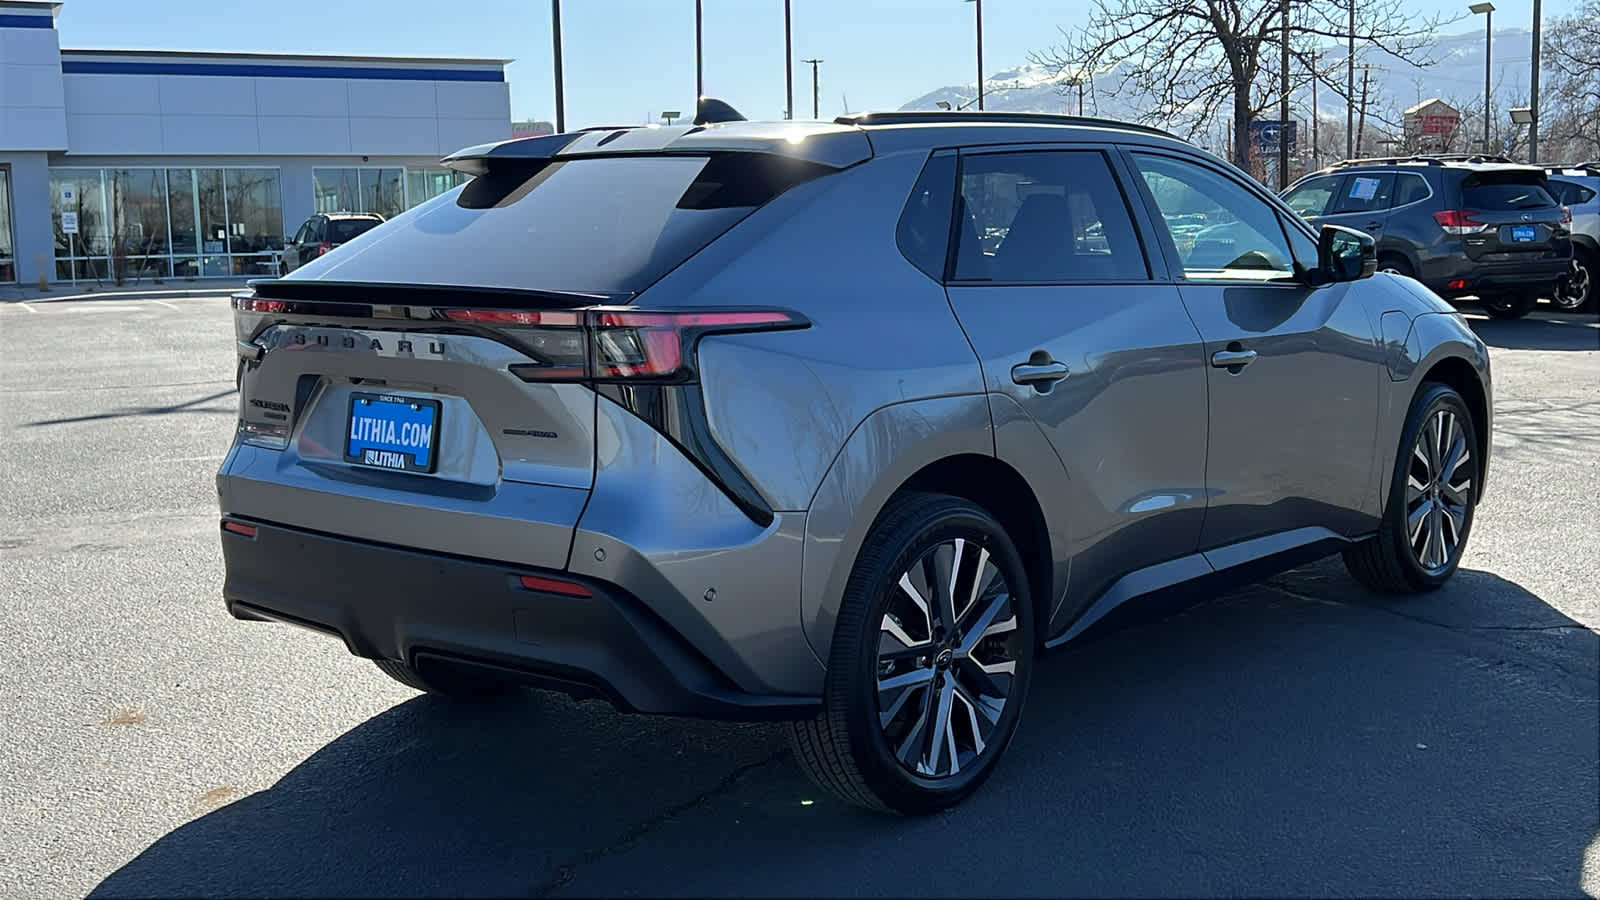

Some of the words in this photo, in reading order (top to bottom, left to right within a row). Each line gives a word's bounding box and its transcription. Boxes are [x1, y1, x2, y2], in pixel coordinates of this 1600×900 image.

[294, 334, 446, 355] SUBARU
[350, 416, 433, 449] LITHIA.COM
[373, 450, 405, 469] LITHIA
